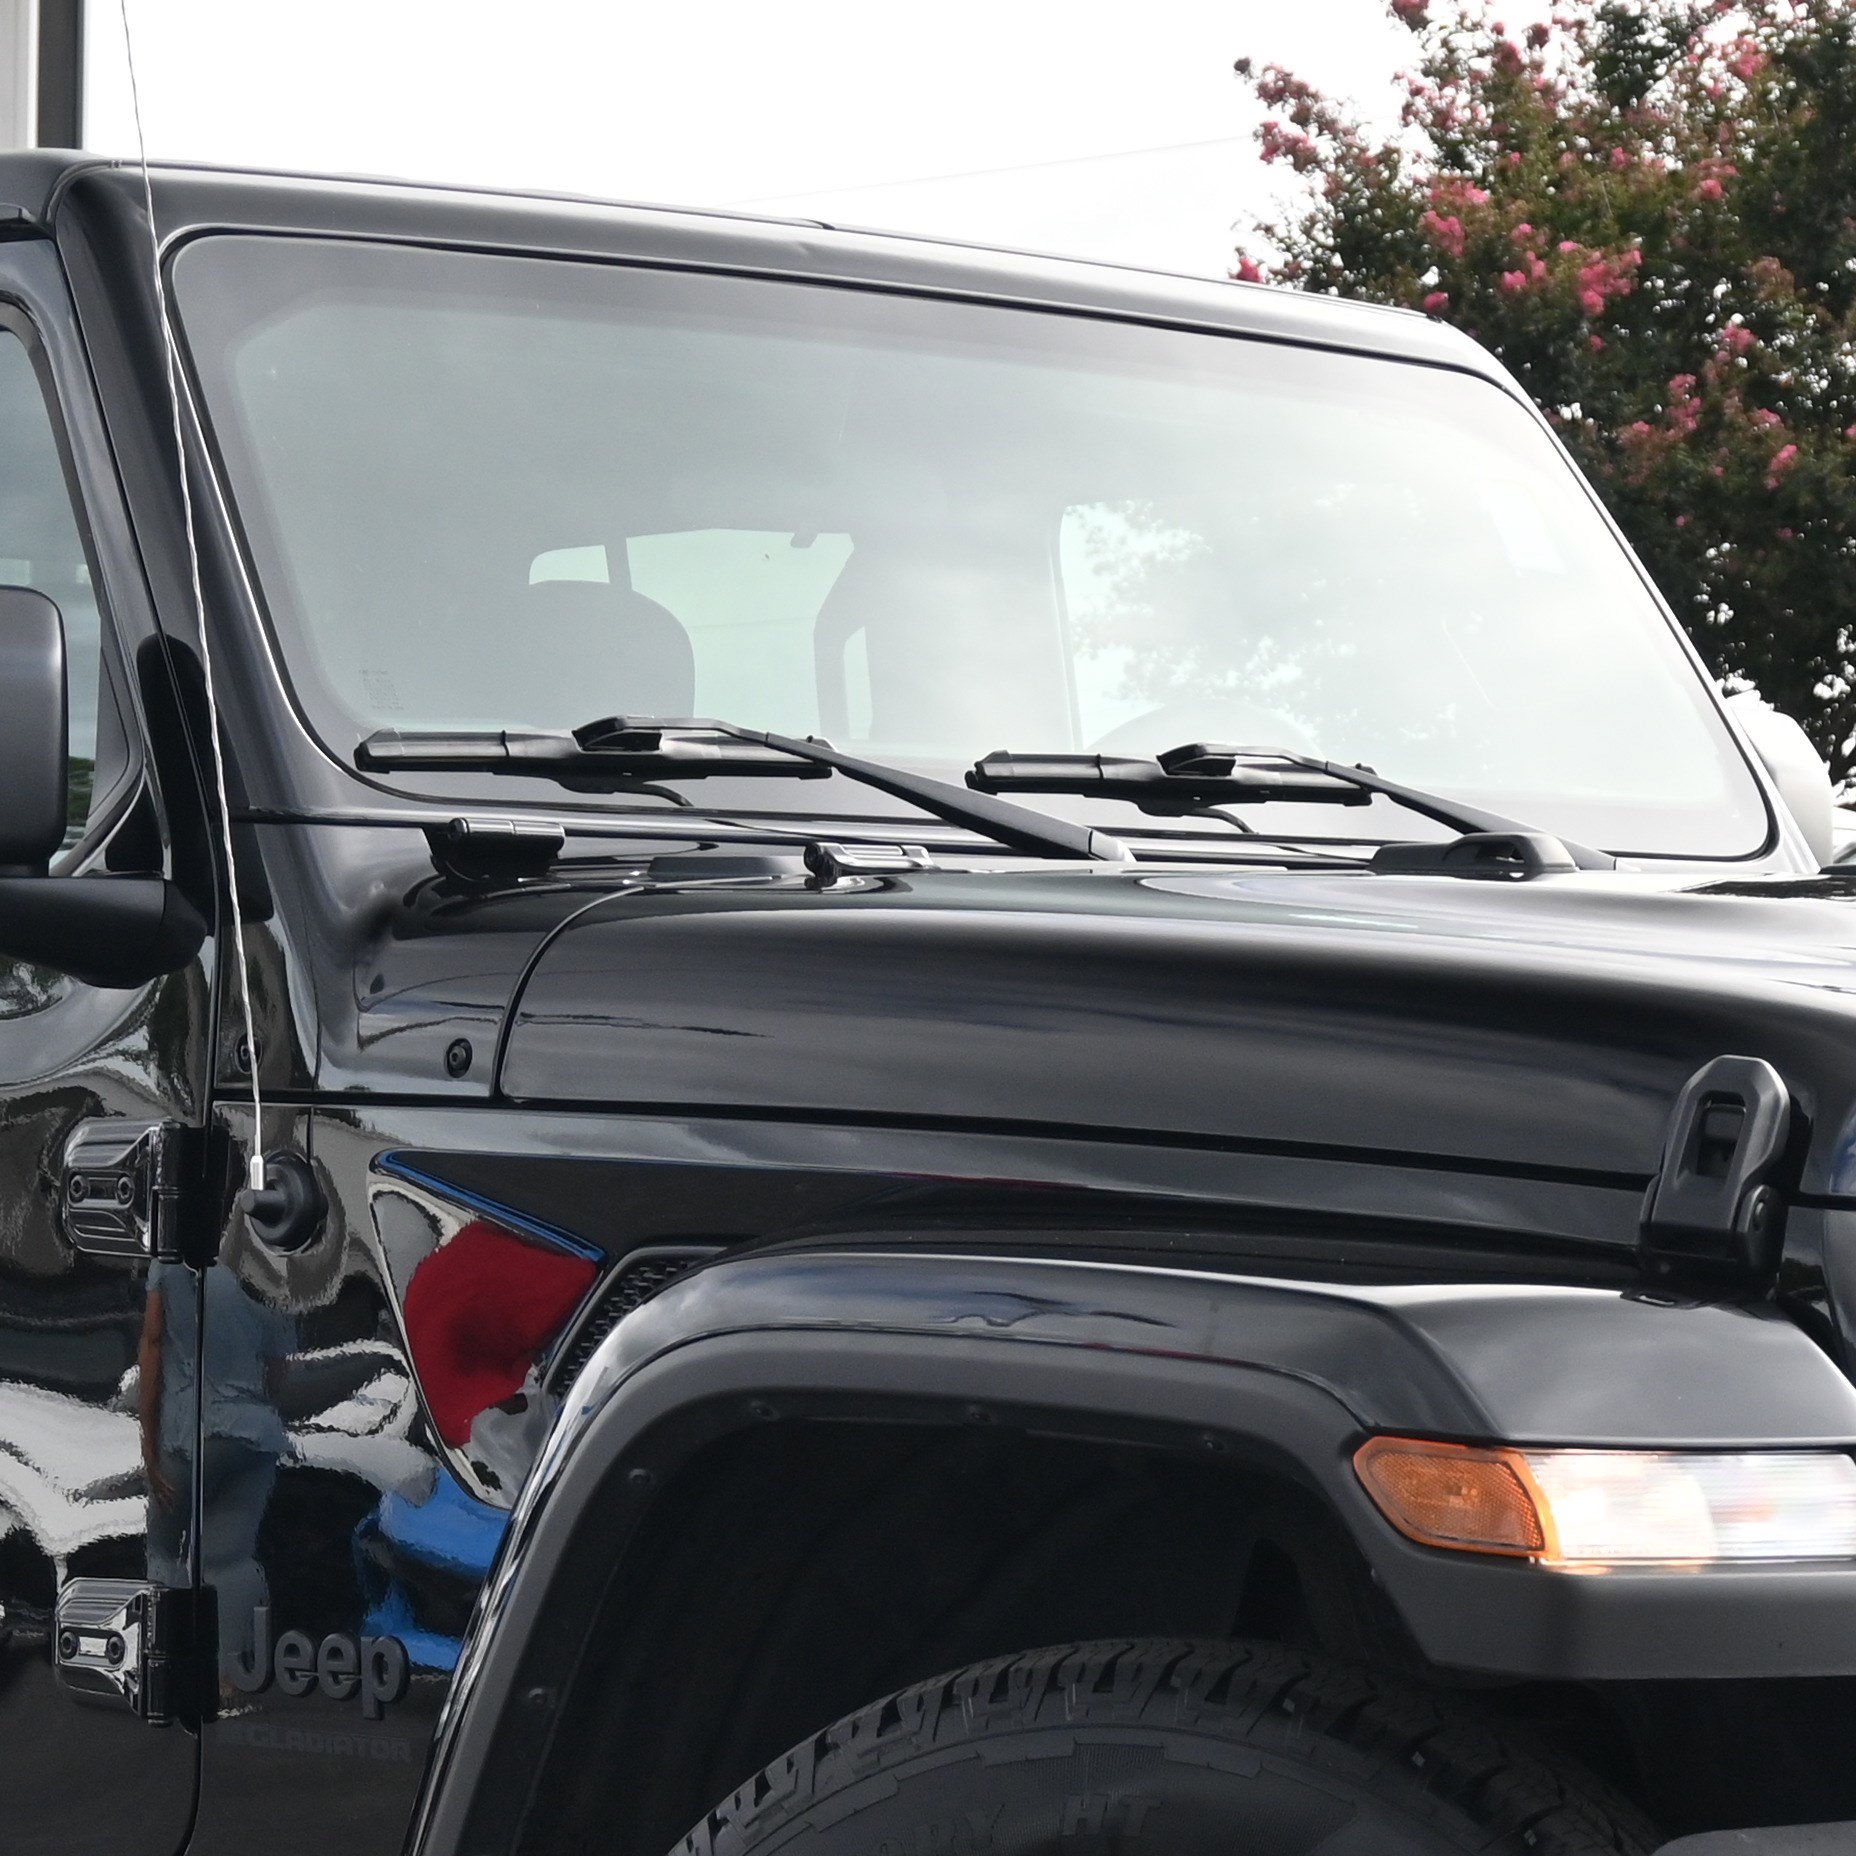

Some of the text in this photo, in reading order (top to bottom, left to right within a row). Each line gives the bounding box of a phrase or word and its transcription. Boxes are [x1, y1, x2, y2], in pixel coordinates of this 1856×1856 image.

[227, 1604, 412, 1721] Jeep
[250, 1725, 411, 1763] GLADIATOR
[1061, 1794, 1161, 1837] HT
